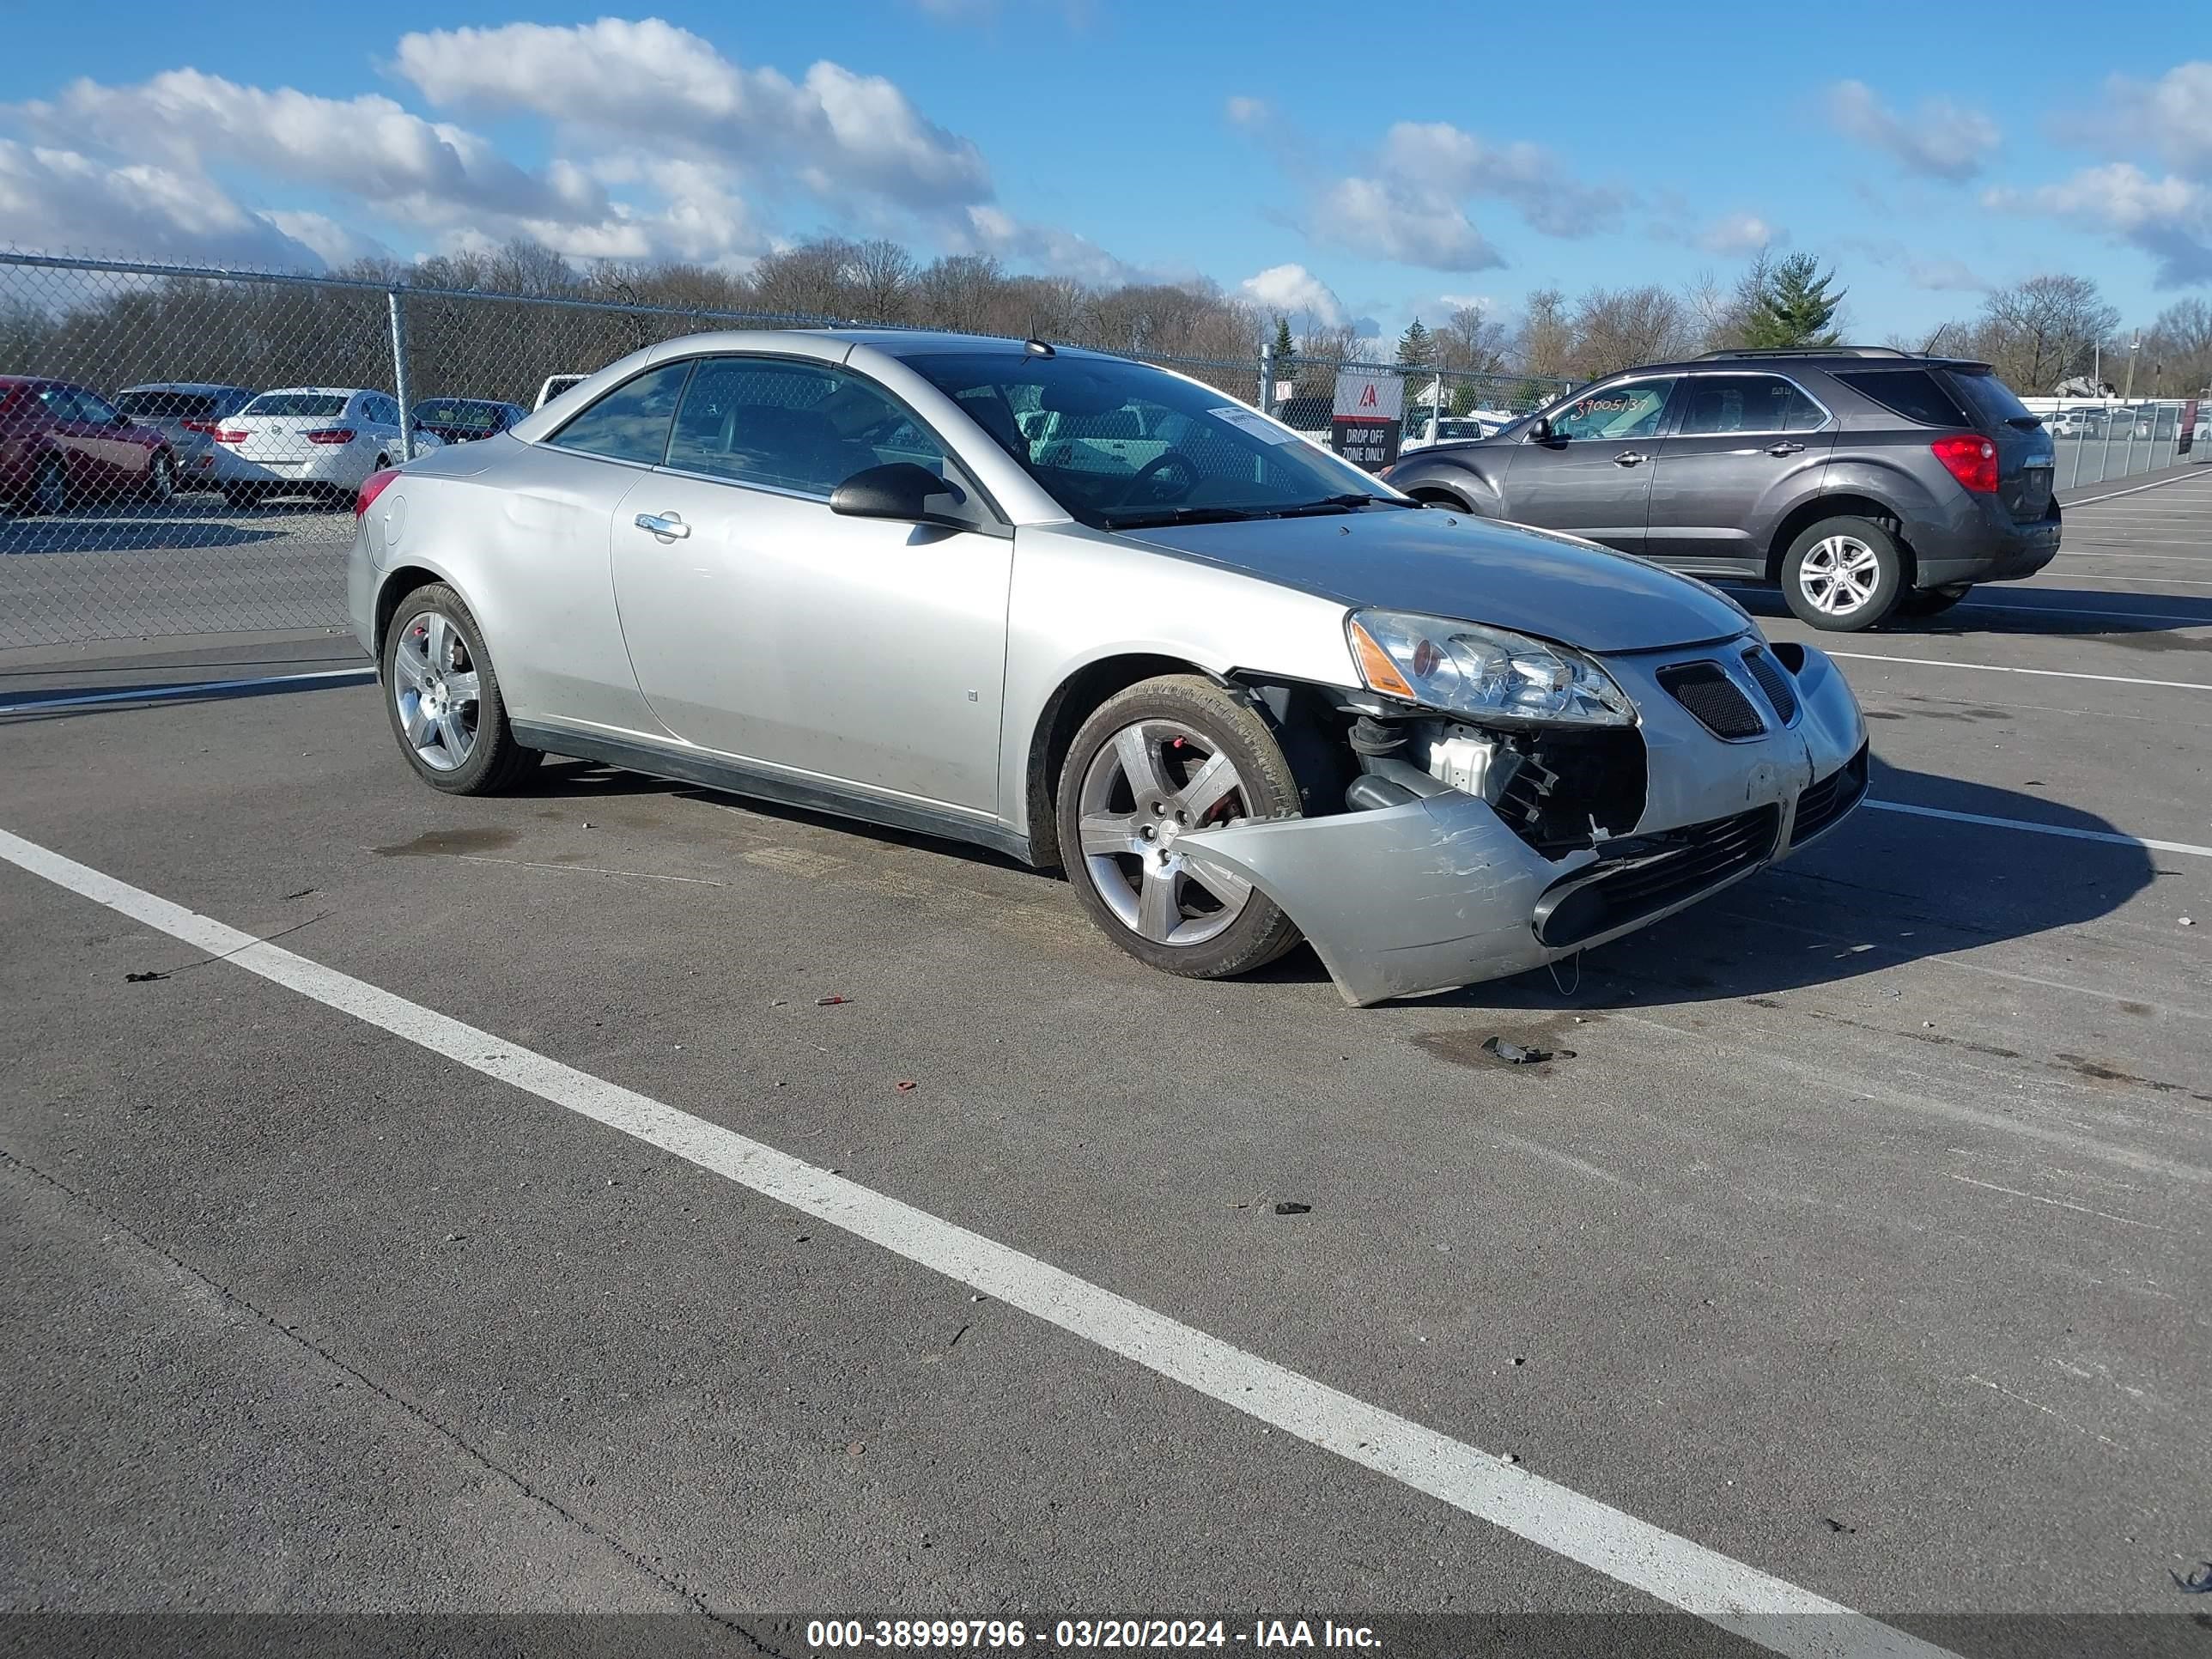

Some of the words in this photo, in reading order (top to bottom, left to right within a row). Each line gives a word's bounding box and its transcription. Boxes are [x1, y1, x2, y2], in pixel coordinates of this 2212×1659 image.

[1570, 398, 1648, 421] 39005137
[1346, 428, 1369, 444] DROP
[1370, 429, 1384, 445] OFF
[1341, 447, 1364, 462] ZONE
[1364, 447, 1386, 462] ONLY
